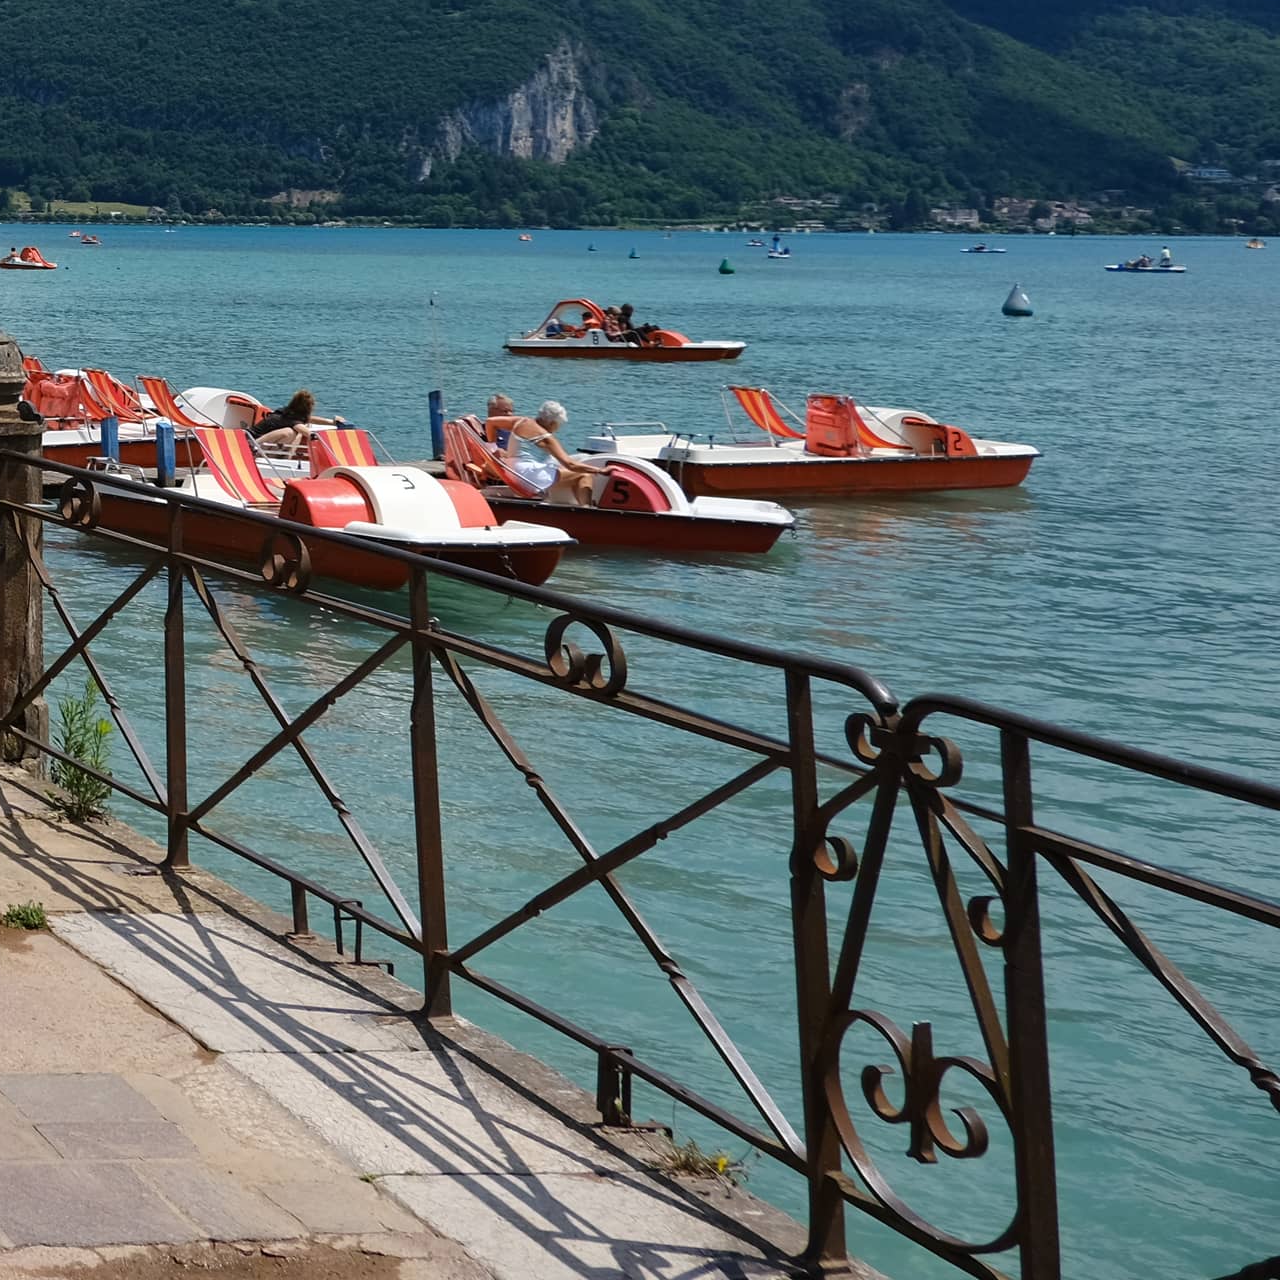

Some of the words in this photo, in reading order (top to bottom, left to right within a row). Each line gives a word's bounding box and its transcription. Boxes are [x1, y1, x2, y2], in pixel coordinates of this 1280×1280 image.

[951, 431, 962, 451] 2
[392, 473, 415, 490] 3
[612, 480, 630, 504] 5
